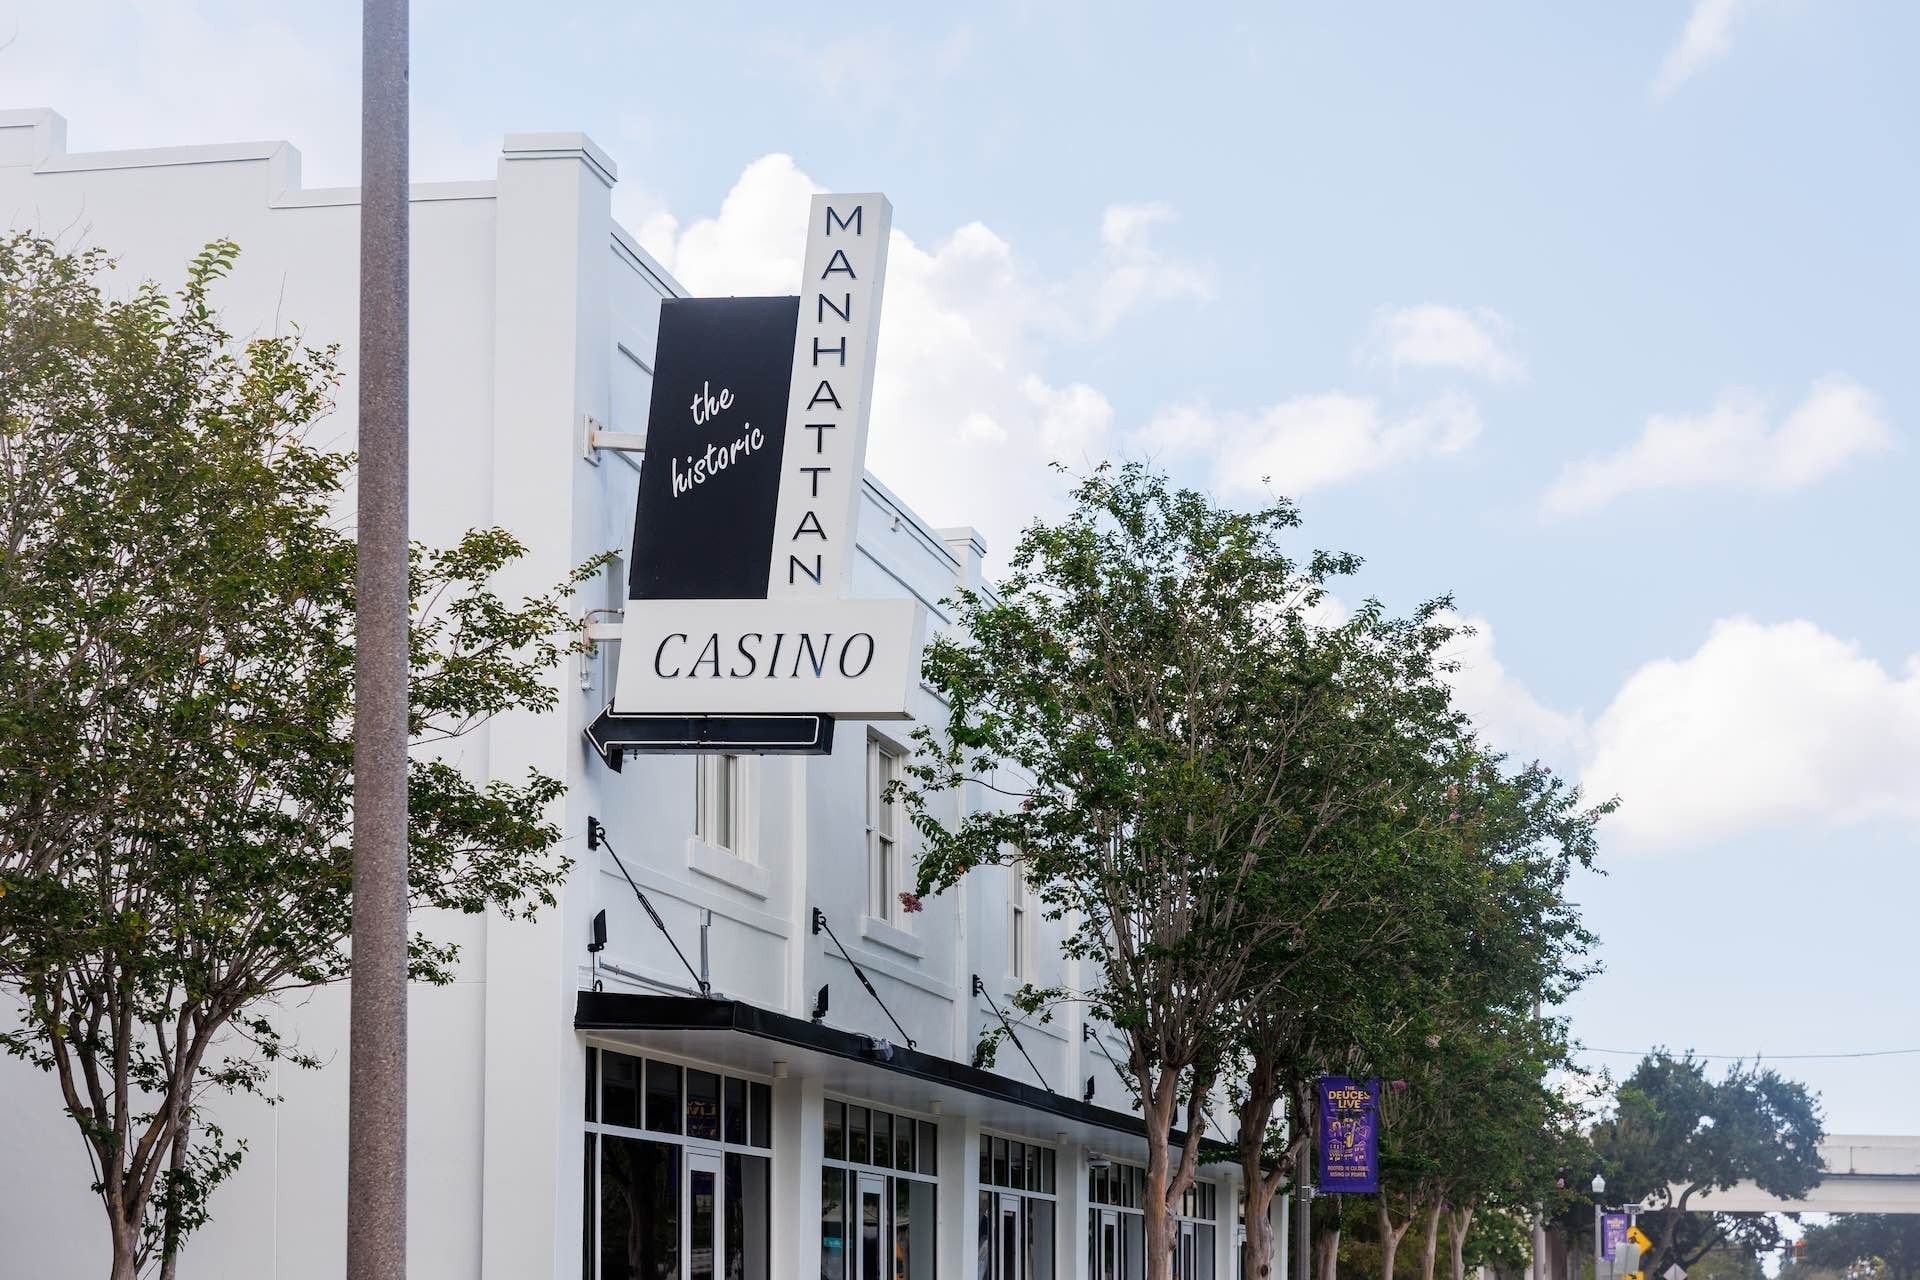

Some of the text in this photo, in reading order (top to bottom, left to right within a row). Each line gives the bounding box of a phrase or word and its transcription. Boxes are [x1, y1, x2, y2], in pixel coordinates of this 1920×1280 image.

[690, 380, 735, 426] the
[789, 205, 863, 585] MANHATTAN
[671, 421, 765, 498] historic
[654, 632, 875, 679] CASINO
[1338, 1100, 1361, 1109] LIVE
